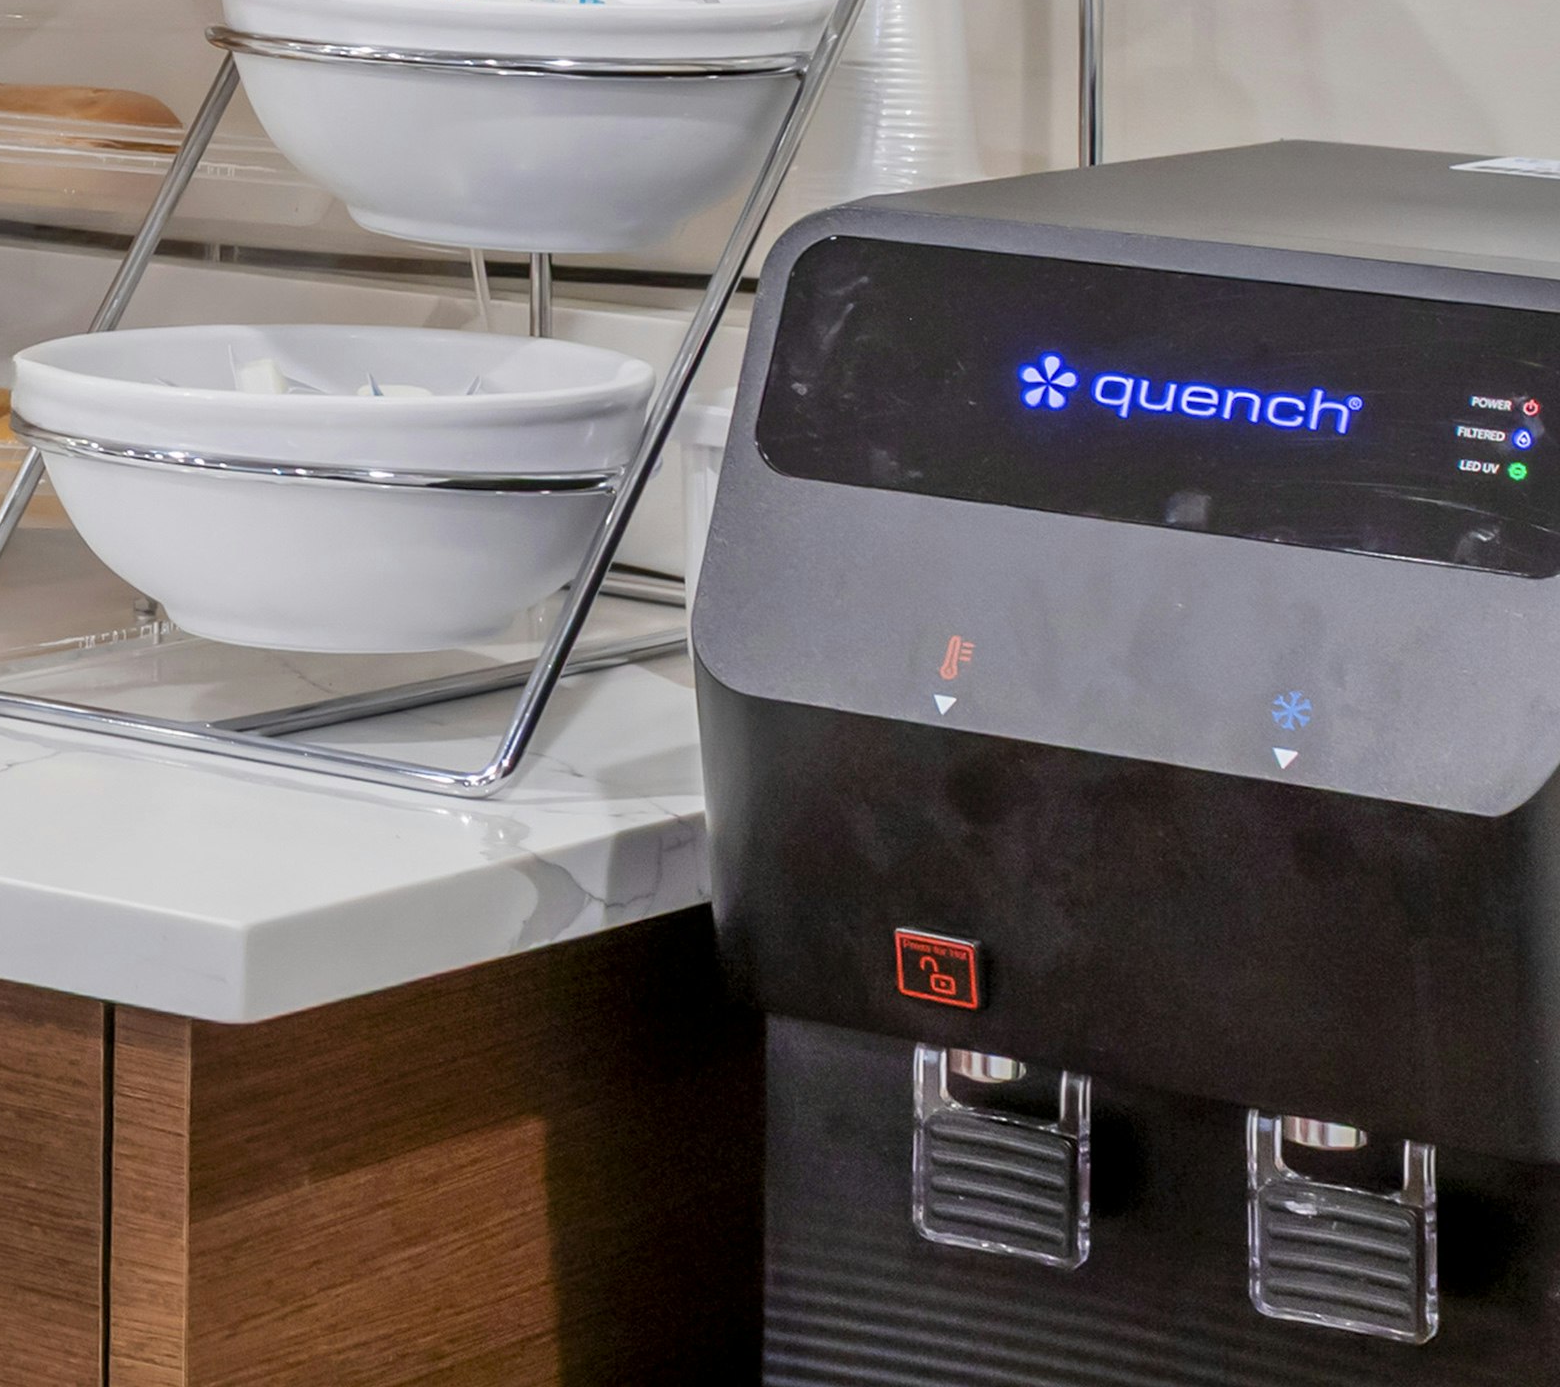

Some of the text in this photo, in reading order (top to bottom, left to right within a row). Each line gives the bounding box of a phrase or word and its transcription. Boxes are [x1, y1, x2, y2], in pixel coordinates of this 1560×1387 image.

[1093, 374, 1351, 435] quench
[1470, 395, 1512, 411] POWER
[1457, 425, 1506, 442] FILTERED
[1459, 459, 1500, 474] LED UV
